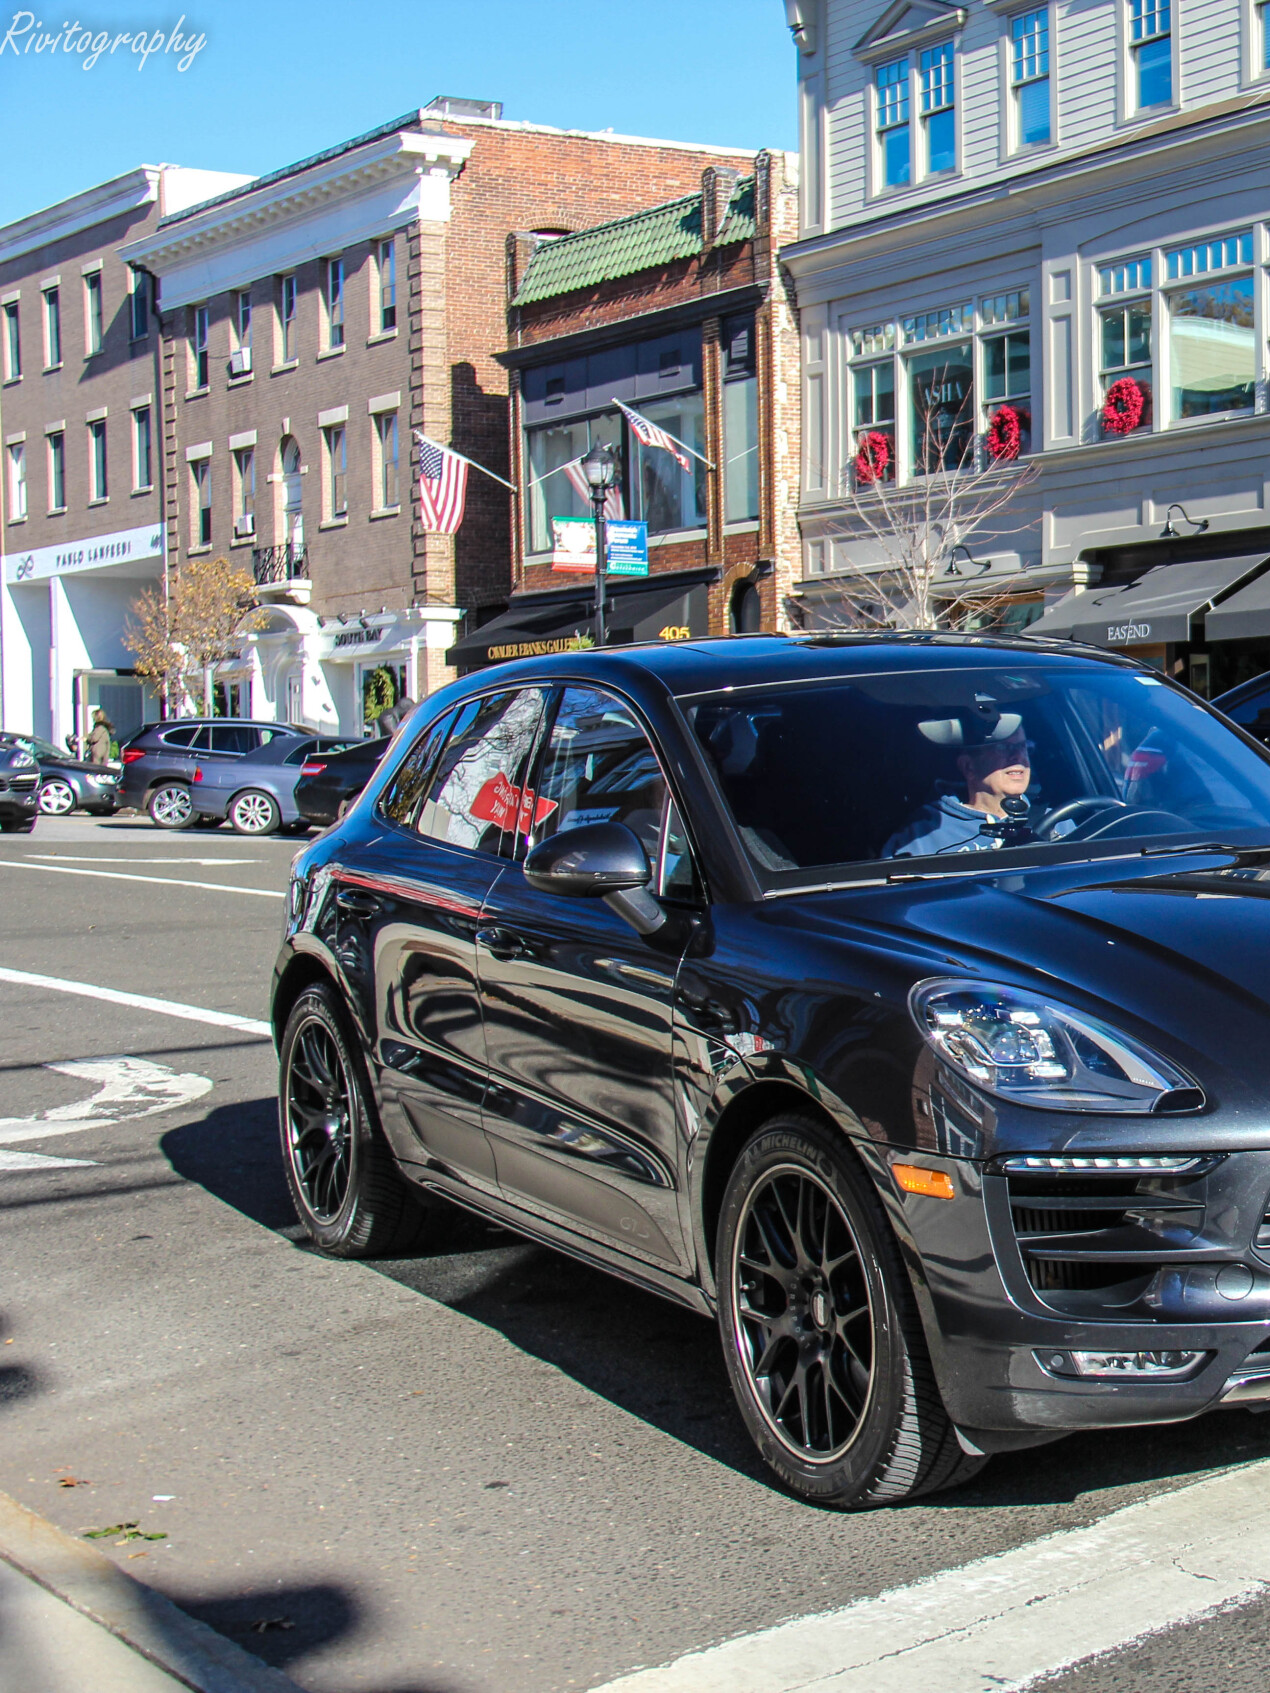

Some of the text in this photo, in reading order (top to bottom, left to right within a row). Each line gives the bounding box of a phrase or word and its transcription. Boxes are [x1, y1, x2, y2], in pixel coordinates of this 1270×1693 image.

[335, 627, 383, 646] SOUTH BAY
[658, 626, 690, 640] 405
[761, 1134, 818, 1160] MICHELIN
